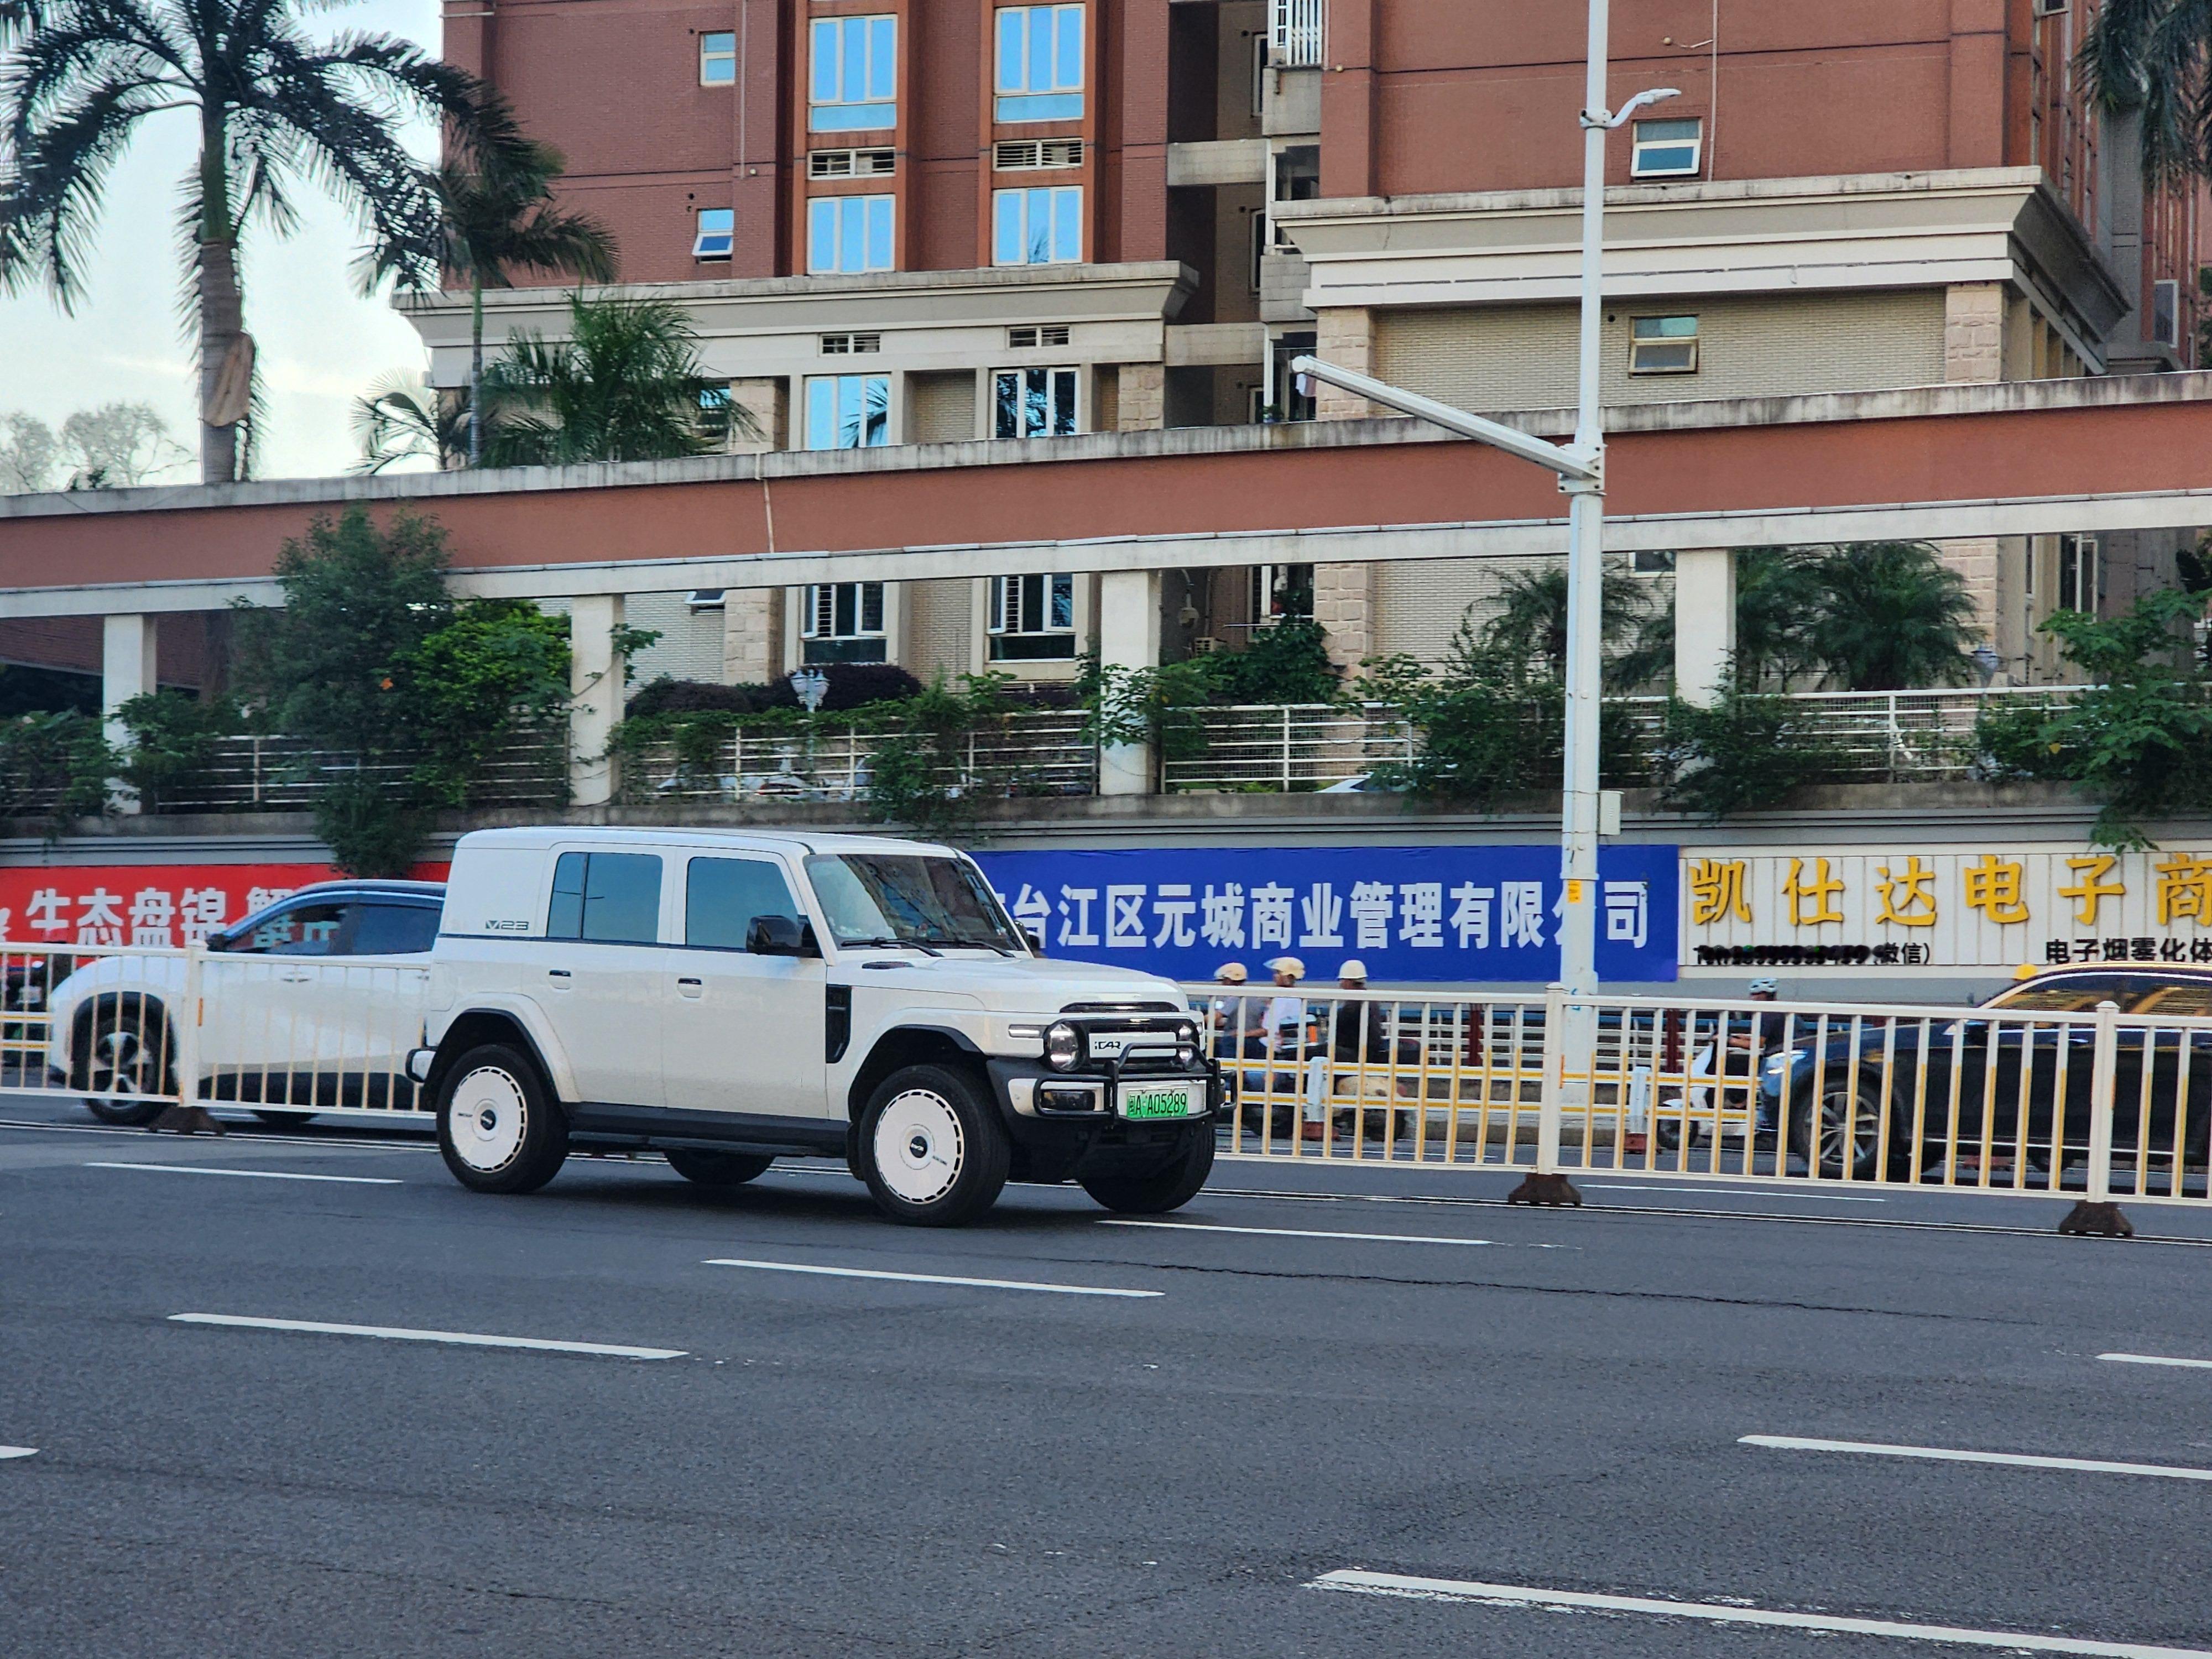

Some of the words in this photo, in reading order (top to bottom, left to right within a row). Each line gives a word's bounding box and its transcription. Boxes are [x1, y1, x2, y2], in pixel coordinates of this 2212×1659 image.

[995, 881, 1648, 950] 台江区元城商业管理有限司
[1688, 853, 2212, 927] 凯仕达电子商
[486, 920, 529, 930] V23
